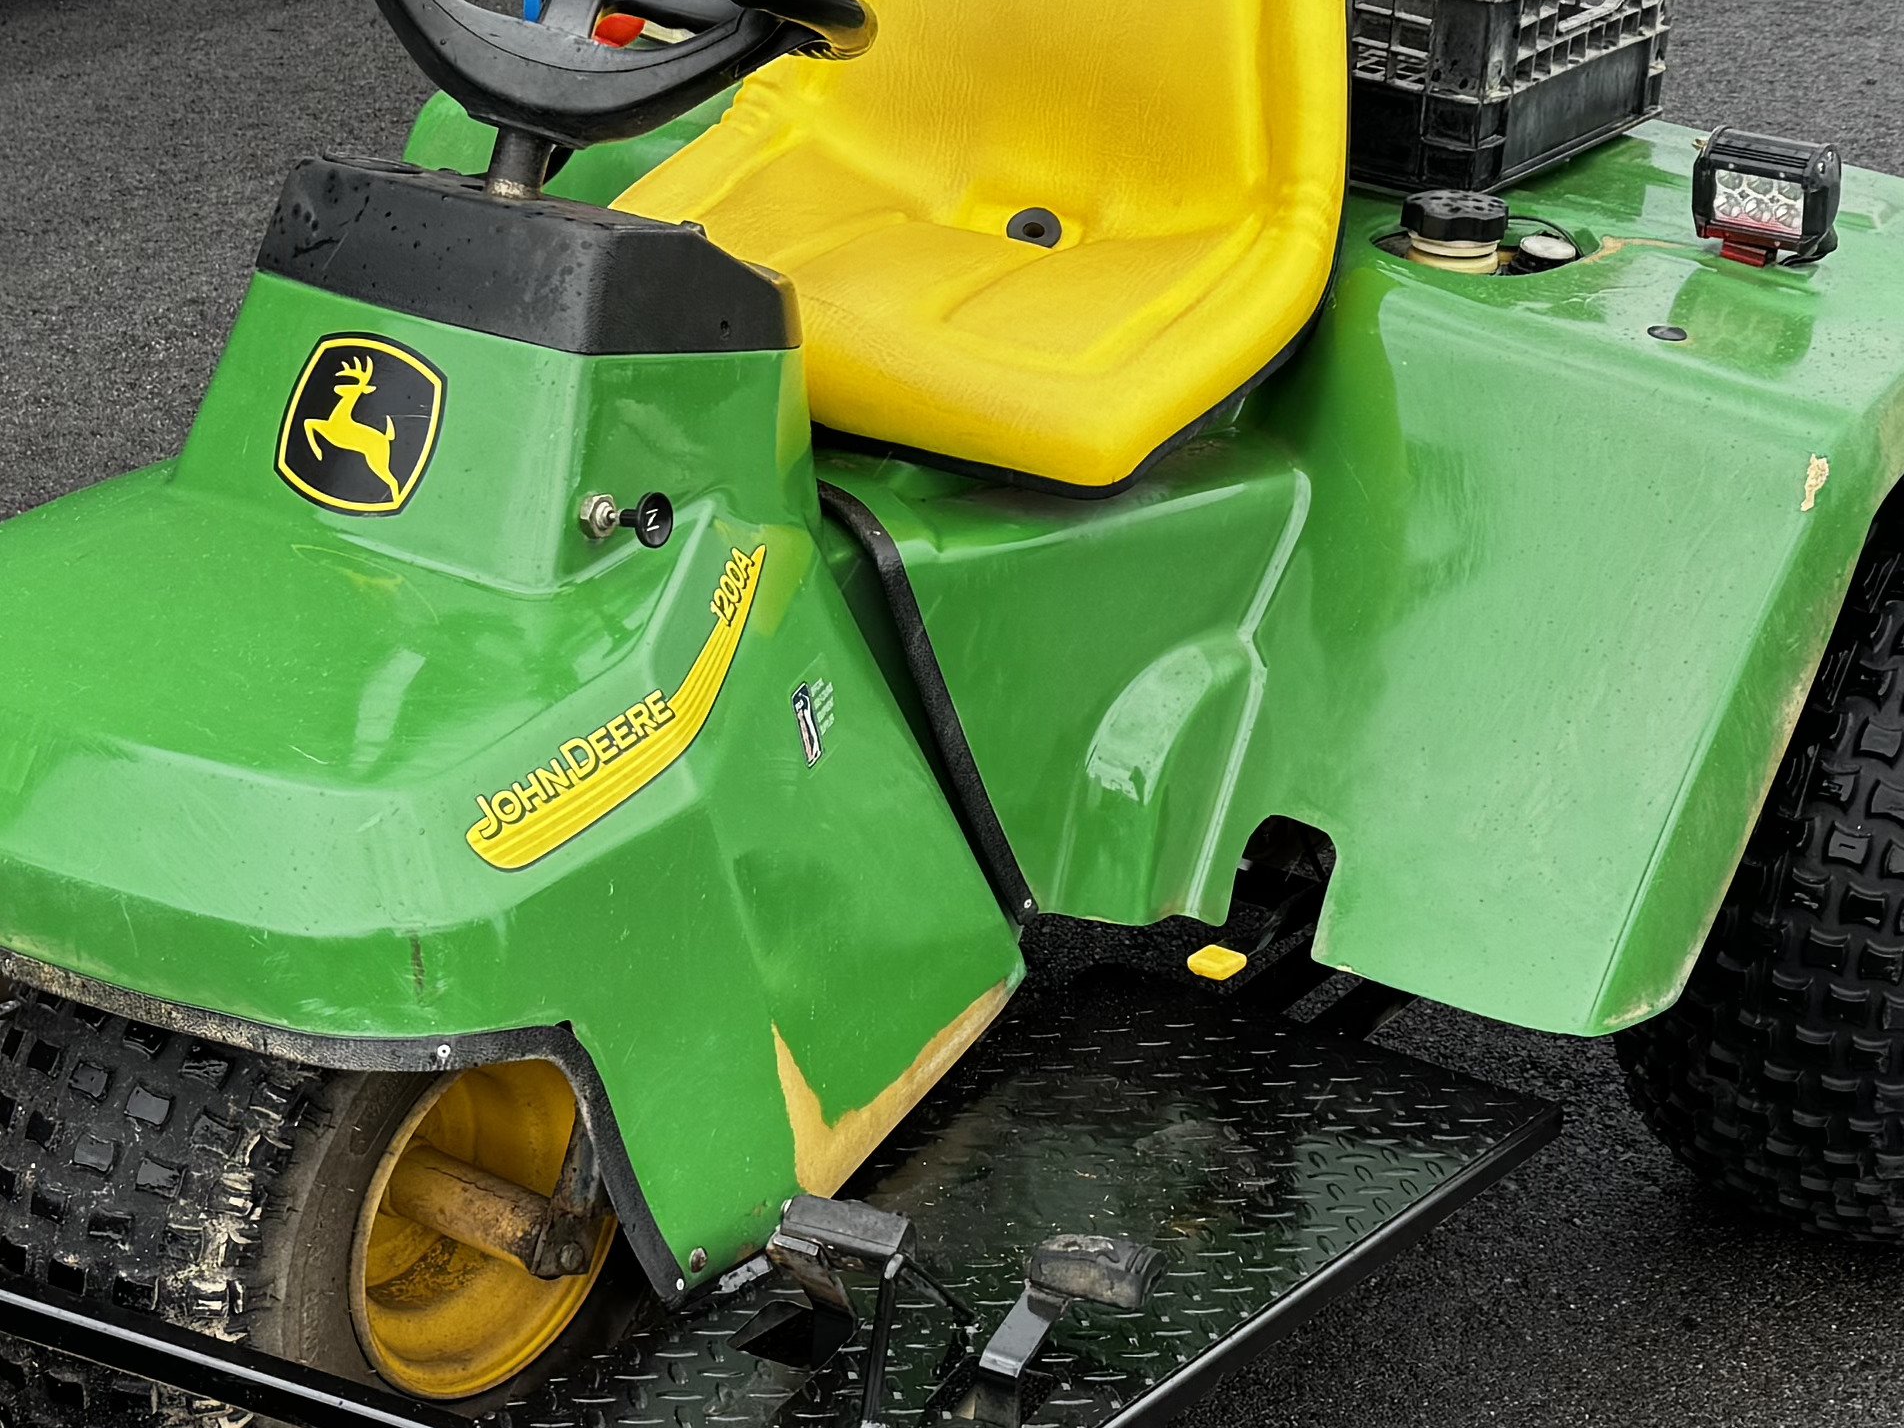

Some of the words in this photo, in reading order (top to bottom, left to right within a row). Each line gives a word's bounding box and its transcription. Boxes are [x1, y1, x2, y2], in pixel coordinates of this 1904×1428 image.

[710, 547, 756, 626] 1200A
[476, 757, 575, 840] JOHN
[559, 689, 676, 781] DEERE
